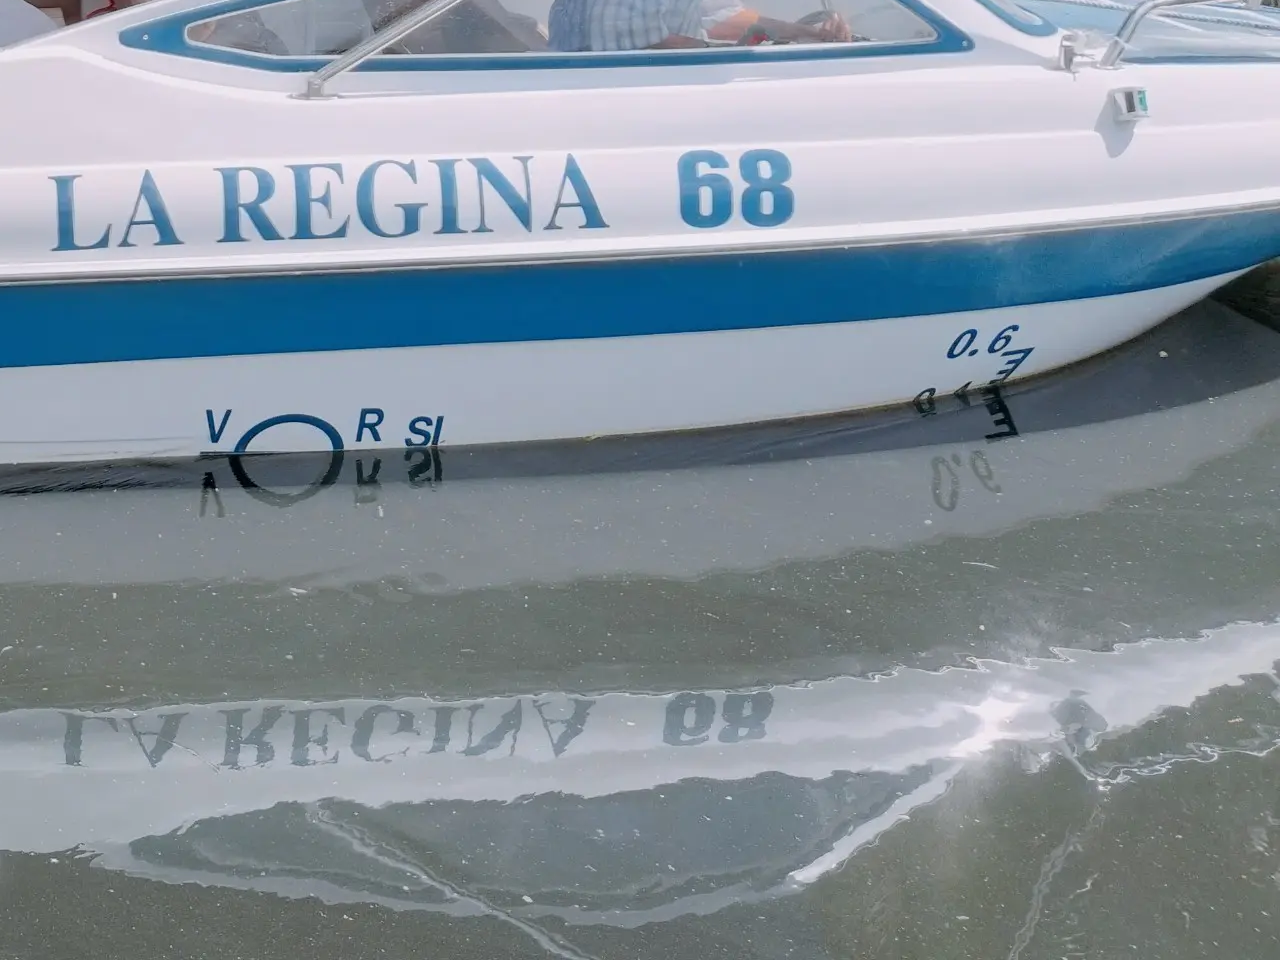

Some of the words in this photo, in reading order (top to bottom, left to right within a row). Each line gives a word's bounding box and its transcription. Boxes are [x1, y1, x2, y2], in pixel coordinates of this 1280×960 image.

[48, 169, 185, 251] LA
[213, 152, 610, 240] REGINA
[677, 148, 795, 228] 68
[947, 324, 1019, 359] 0.6
